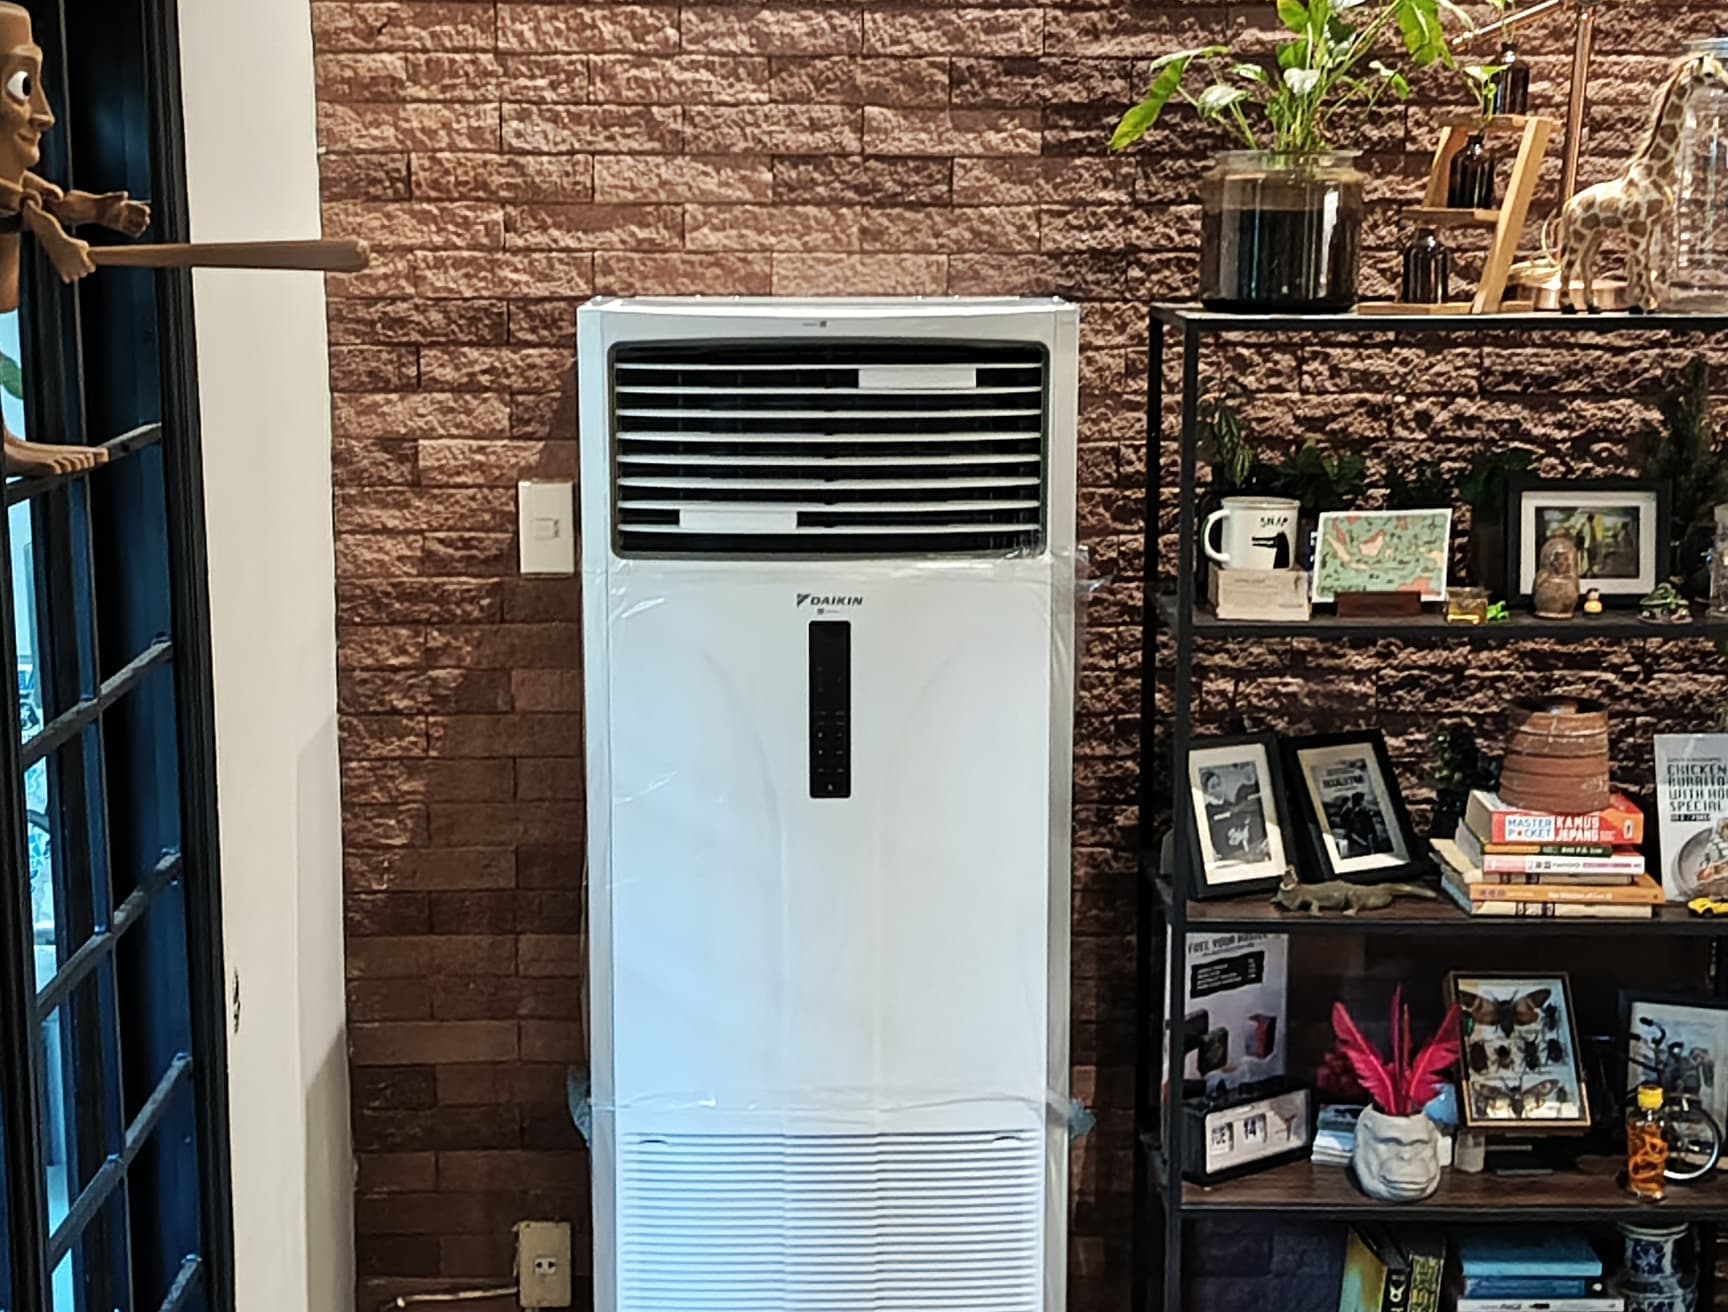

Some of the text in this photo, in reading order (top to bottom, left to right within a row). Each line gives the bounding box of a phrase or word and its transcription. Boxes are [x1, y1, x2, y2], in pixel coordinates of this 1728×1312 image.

[809, 596, 864, 606] DAIKIN
[1670, 800, 1721, 812] SPECIAL
[1508, 818, 1552, 828] MASTER
[1556, 816, 1599, 829] KAMUS
[1556, 828, 1599, 842] JEPANG
